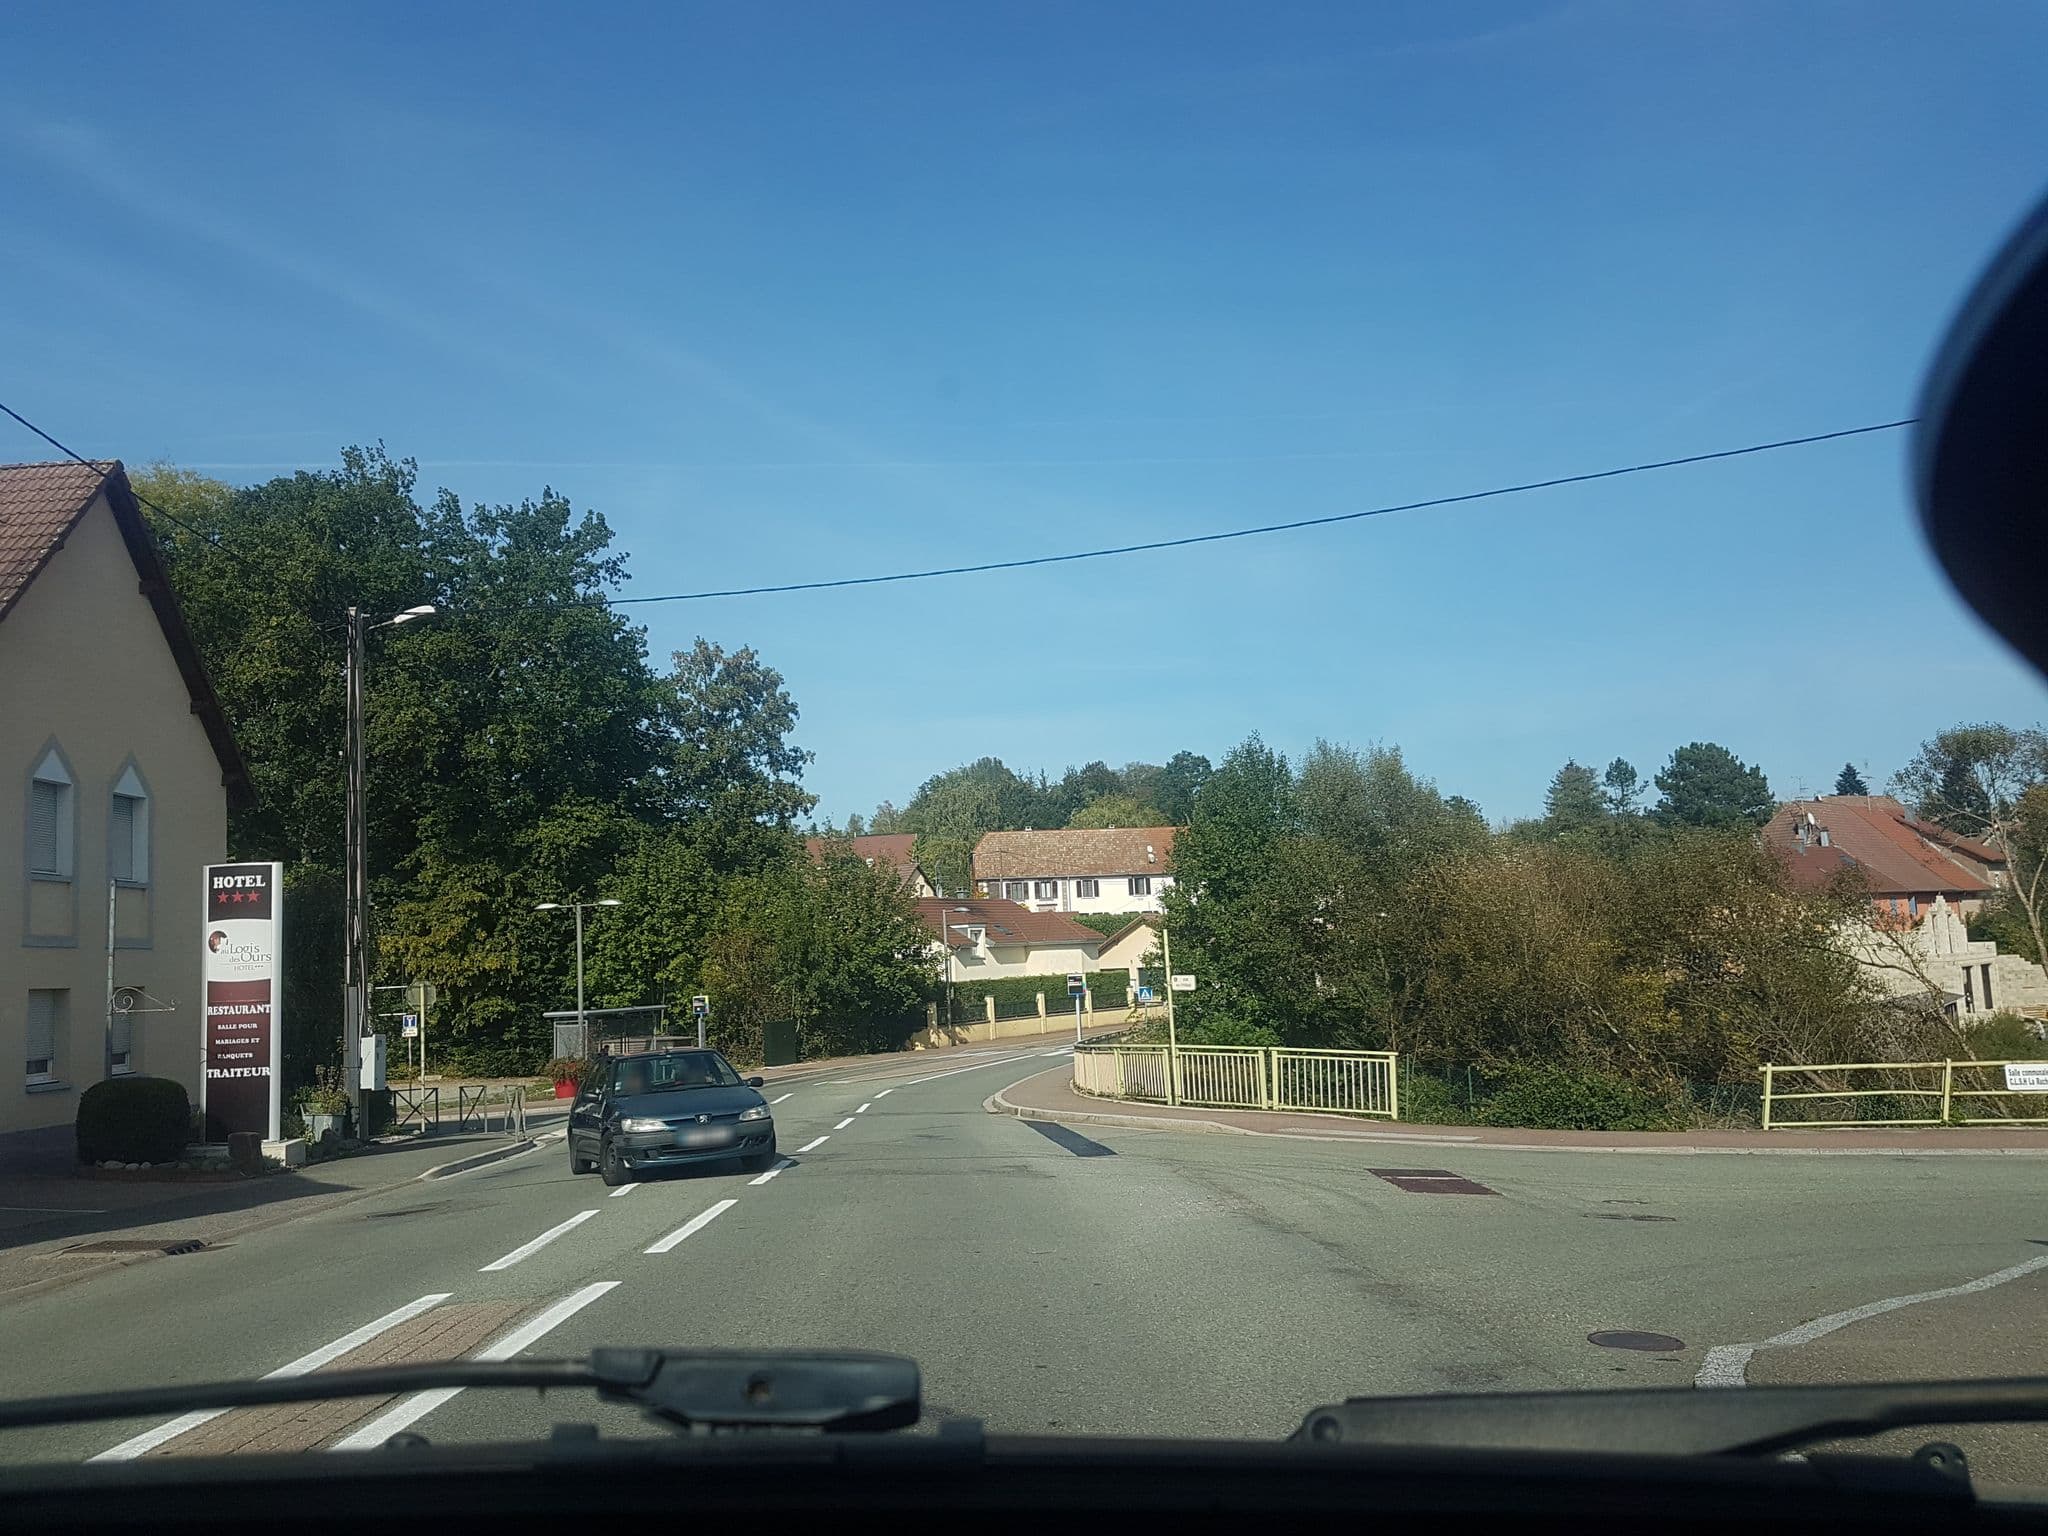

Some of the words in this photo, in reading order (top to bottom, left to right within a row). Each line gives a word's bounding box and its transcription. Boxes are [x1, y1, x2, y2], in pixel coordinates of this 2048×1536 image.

[213, 875, 266, 889] HOTEL
[230, 942, 260, 954] Logis
[240, 952, 272, 962] Ours
[208, 1004, 271, 1016] RESTAURANT
[206, 1066, 271, 1078] TRAITEUR
